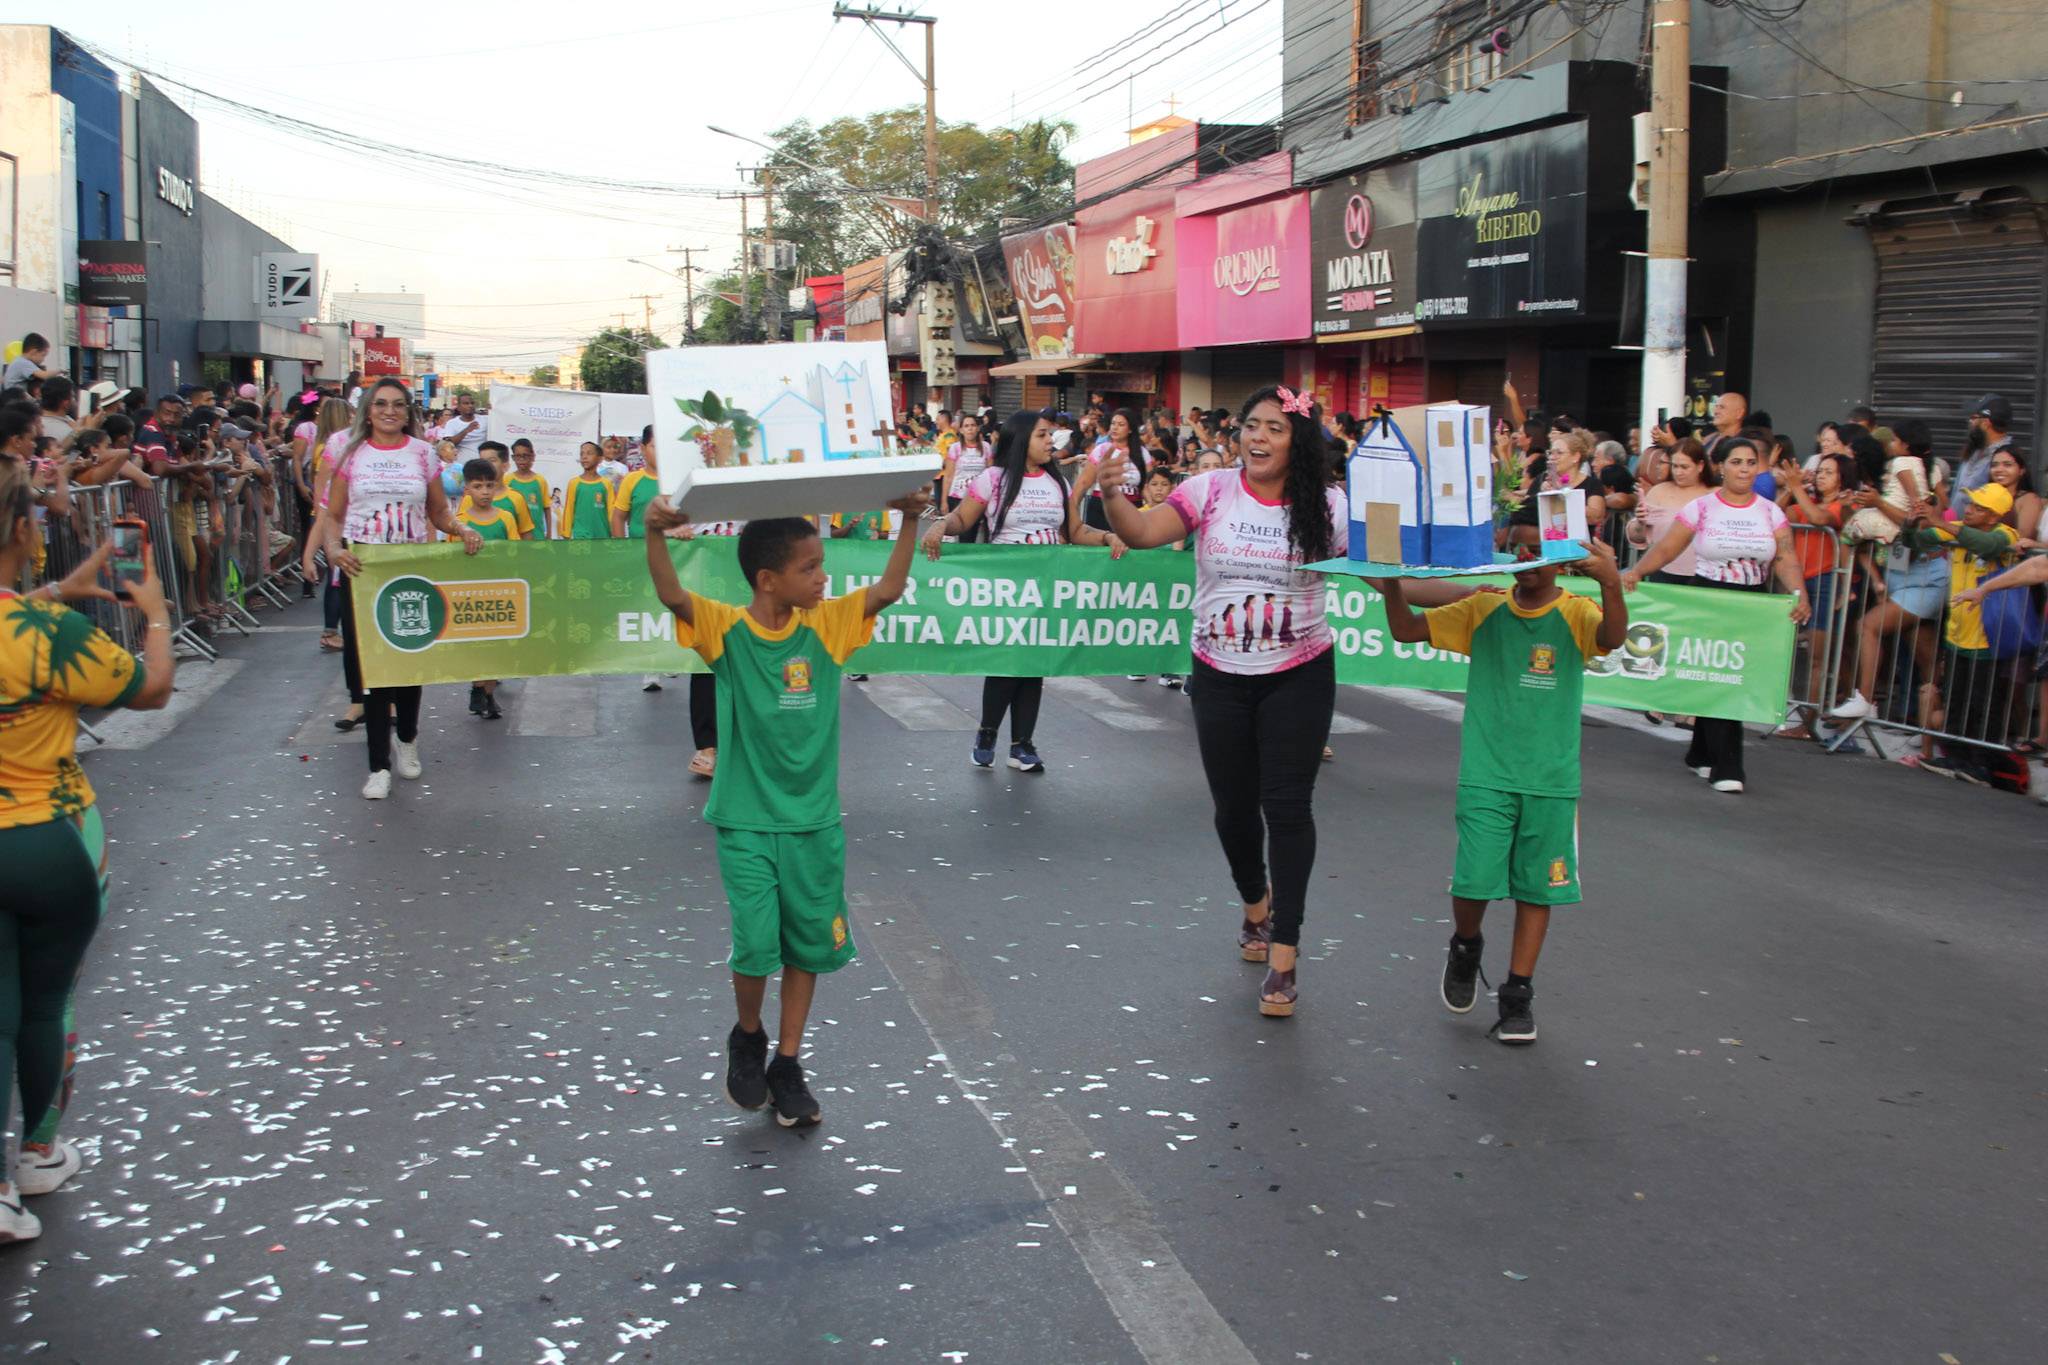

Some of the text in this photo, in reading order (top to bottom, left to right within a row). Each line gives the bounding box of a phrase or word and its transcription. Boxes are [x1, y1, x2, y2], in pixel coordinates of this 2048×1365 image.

[1455, 173, 1519, 228] Aryane
[1477, 210, 1541, 243] RIBEIRO
[1214, 245, 1280, 296] ORIGINAL
[1327, 249, 1393, 292] MORATA
[268, 263, 278, 308] STUDIO
[529, 406, 566, 419] EMEB
[1235, 533, 1278, 545] Professora
[1239, 521, 1283, 538] EMEB
[1205, 536, 1230, 555] Rita
[1226, 558, 1262, 570] Campos
[453, 597, 516, 612] VÁRZEA
[1053, 580, 1159, 610] PRIMA
[453, 611, 517, 625] GRANDE
[954, 616, 1180, 647] AUXILIADORA
[1676, 636, 1746, 671] ANOS
[1708, 672, 1744, 686] GRANDE
